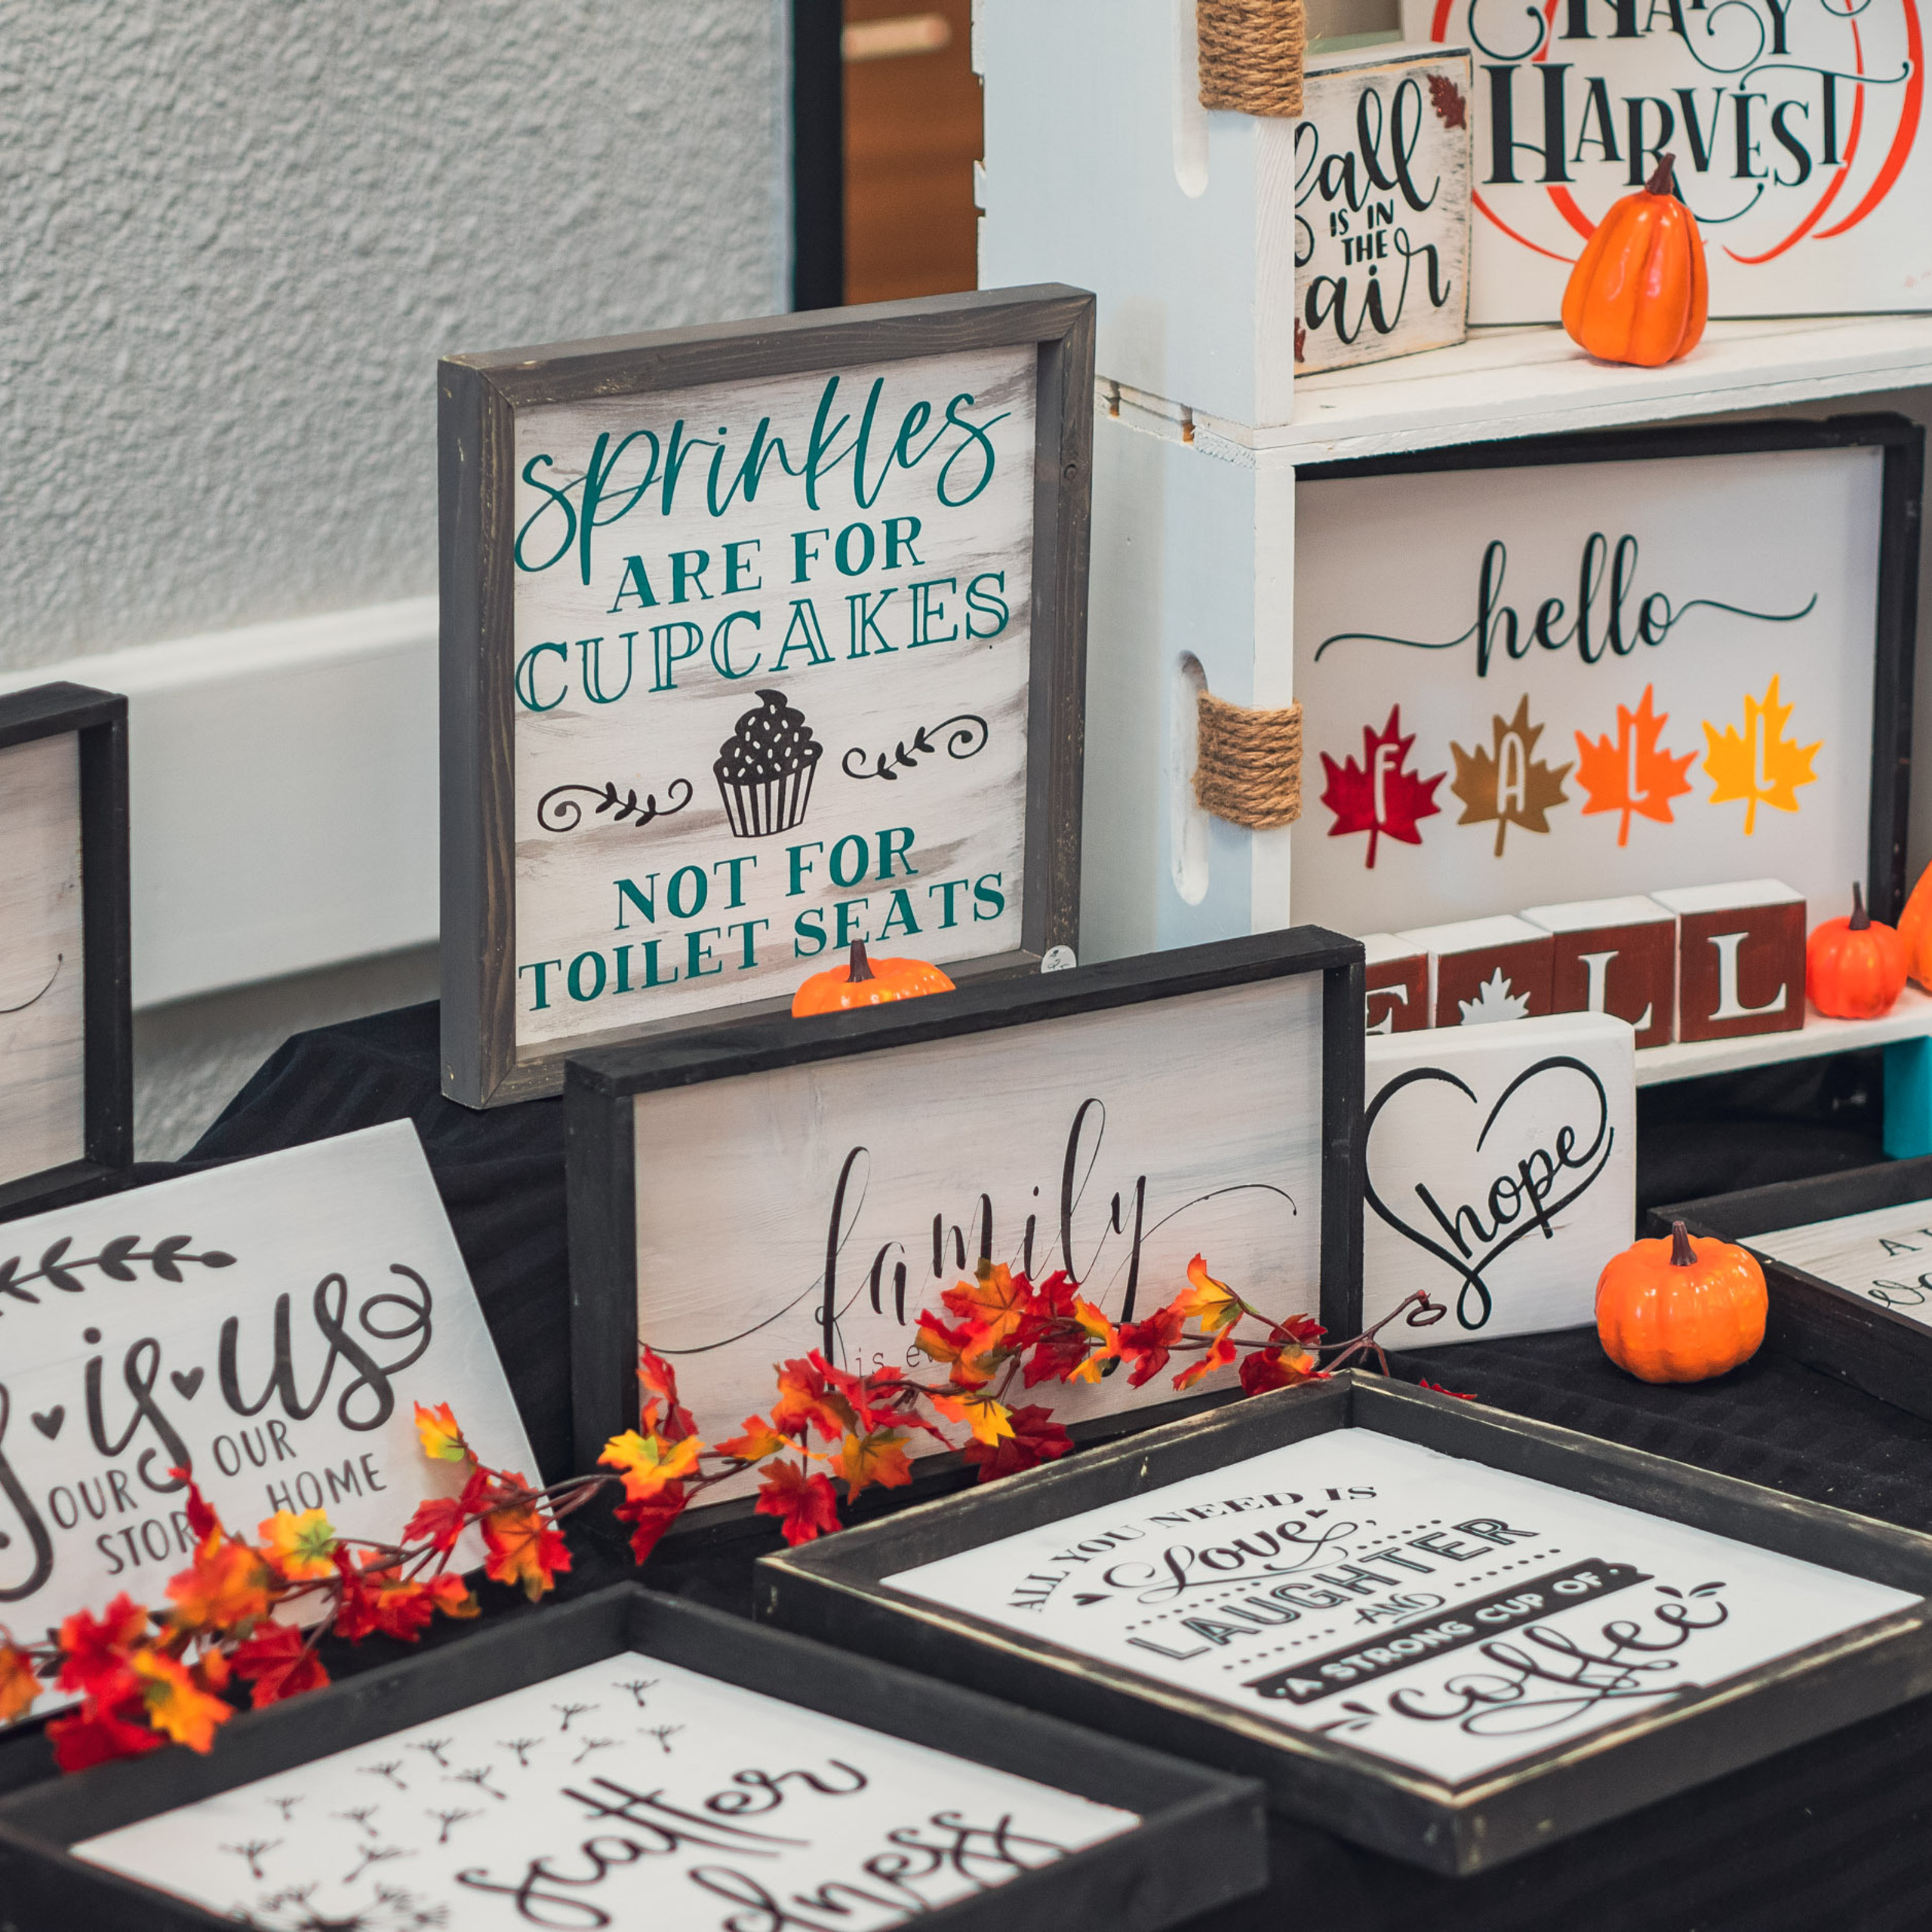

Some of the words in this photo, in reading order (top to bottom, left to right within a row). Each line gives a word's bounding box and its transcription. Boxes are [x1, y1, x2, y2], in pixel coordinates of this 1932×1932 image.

[1480, 62, 1910, 222] HARVEST
[1329, 208, 1349, 236] IS
[1367, 199, 1393, 229] IN
[1341, 229, 1387, 265] THE
[1305, 228, 1451, 344] air
[515, 376, 1011, 585] sprinkles
[606, 539, 761, 613] ARE
[790, 516, 924, 584] FOR
[515, 571, 1010, 712] CUPCAKES
[613, 855, 757, 930] NOT
[785, 826, 918, 897] FOR
[518, 919, 769, 1011] TOILET
[793, 872, 1005, 958] SEATS
[1414, 1125, 1577, 1259] hope
[85, 1327, 192, 1494] is
[218, 1263, 432, 1432] us
[48, 1469, 139, 1530] OUR
[211, 1419, 297, 1477] OUR
[266, 1453, 387, 1514] HOME
[96, 1511, 199, 1575] STOR
[1008, 1570, 1071, 1614] ALL
[1050, 1524, 1146, 1564] YOU
[1145, 1492, 1305, 1530] NEED
[1321, 1486, 1378, 1503] IS
[1125, 1515, 1541, 1660] LAUGHTER
[1284, 1676, 1325, 1698] A
[1319, 1619, 1475, 1682] STRONG
[1474, 1591, 1546, 1625] CUP
[1551, 1570, 1604, 1596] OF
[1354, 1592, 1447, 1625] AND
[1387, 1600, 1729, 1737] coffee
